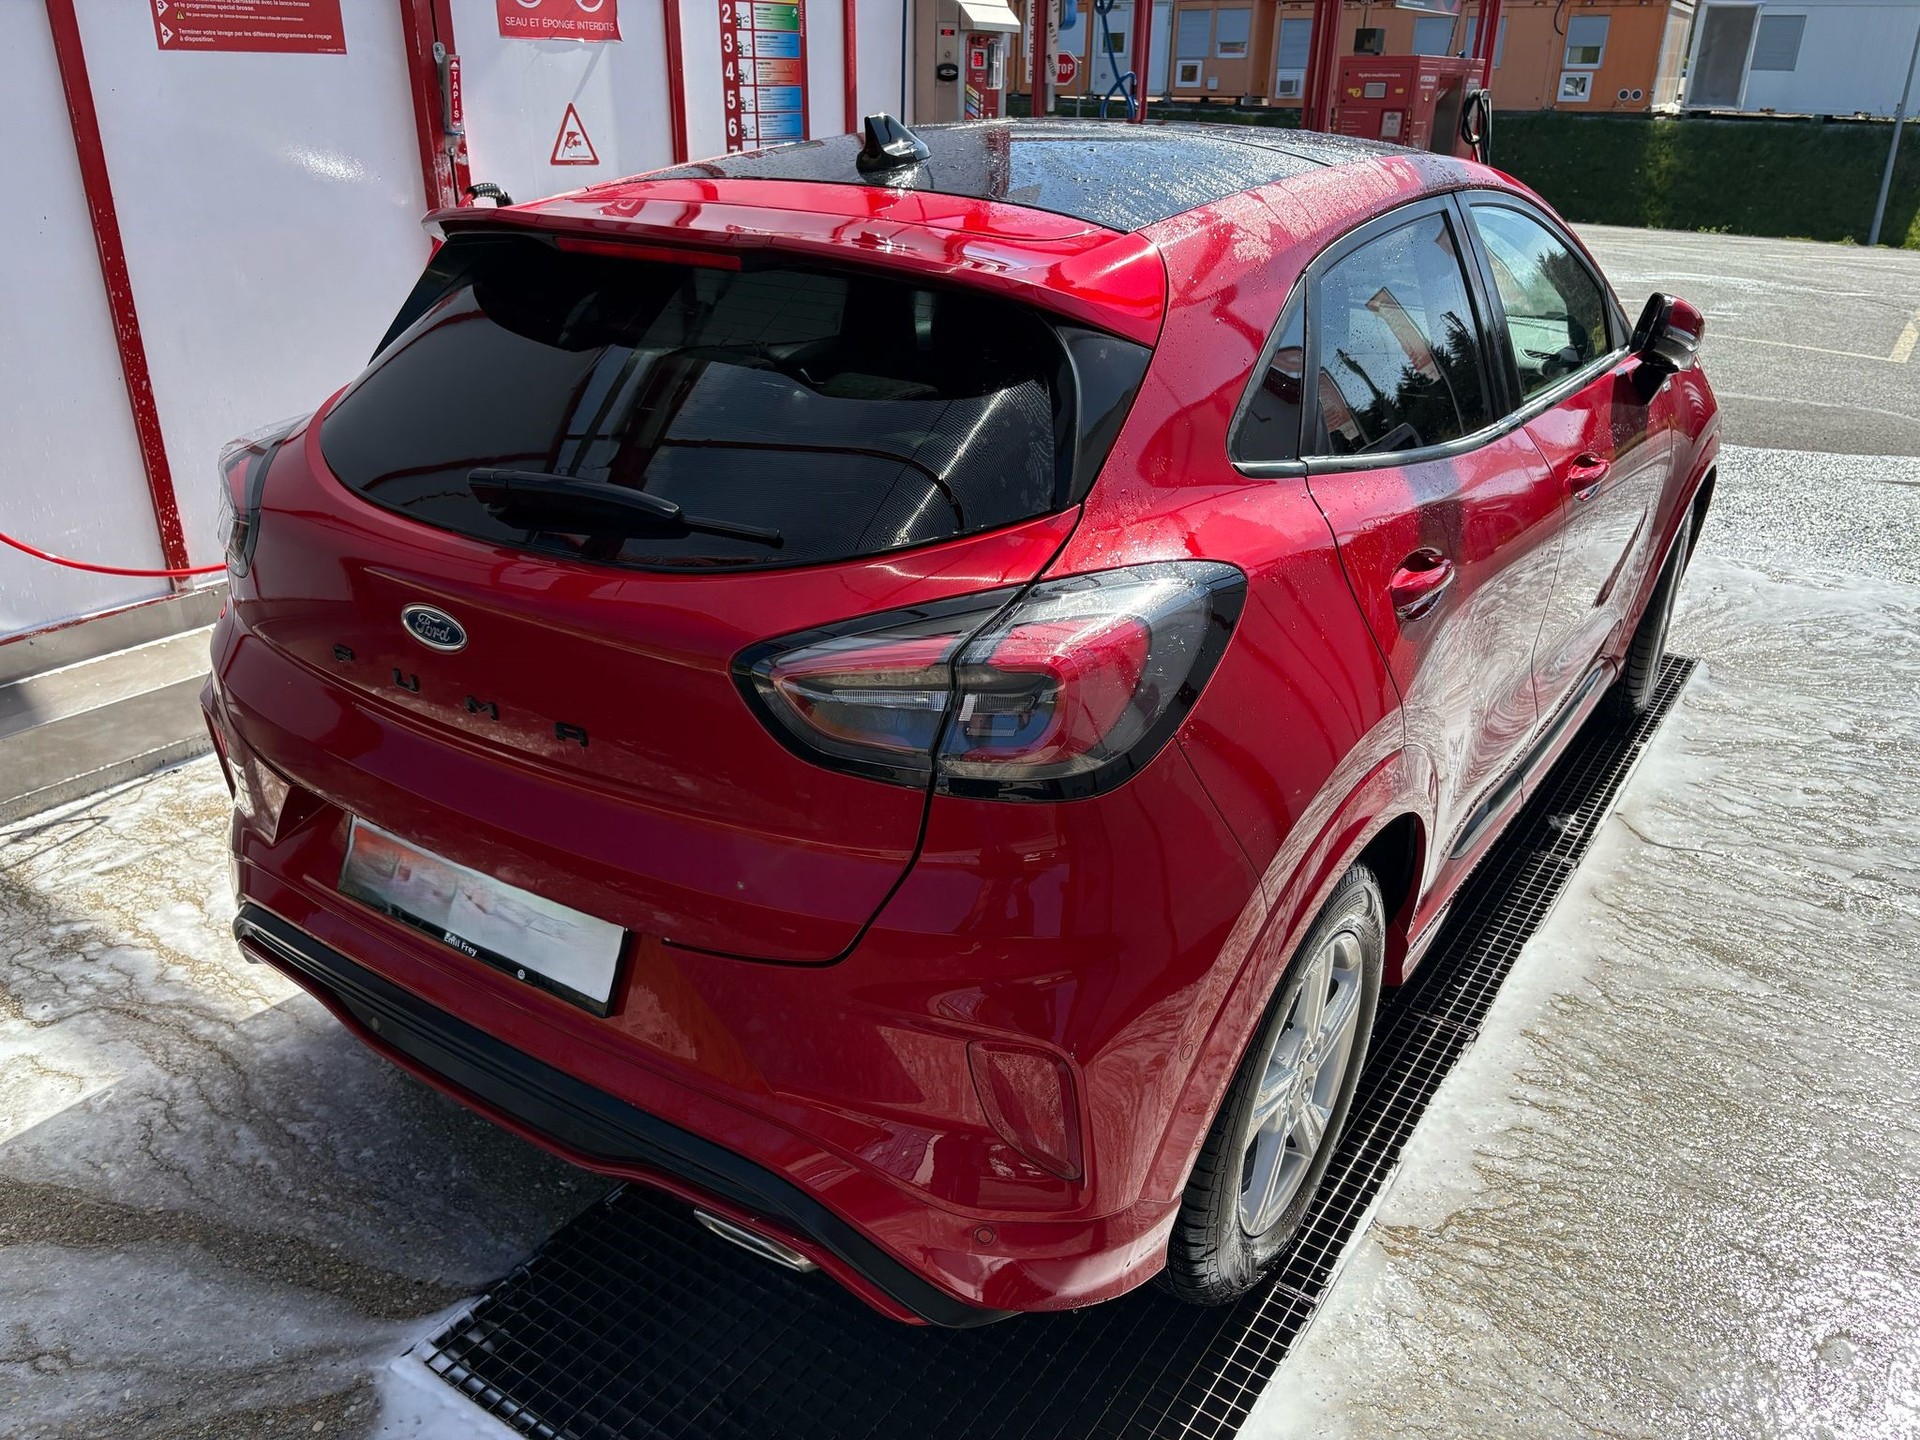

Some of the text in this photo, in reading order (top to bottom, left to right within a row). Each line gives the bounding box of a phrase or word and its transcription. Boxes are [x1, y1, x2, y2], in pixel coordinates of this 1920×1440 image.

[158, 1, 164, 10] 3
[721, 3, 732, 24] 2
[162, 29, 169, 37] 4
[505, 16, 615, 32] SEAU ET ÉPONGE INTERDITS
[723, 32, 733, 54] 3
[725, 61, 735, 81] 4
[1058, 63, 1074, 75] TOP
[451, 71, 460, 119] TAPIS
[727, 90, 737, 110] 5
[728, 117, 738, 137] 6
[416, 612, 451, 642] Ford
[333, 643, 589, 747] PUMA
[444, 931, 478, 957] Emil Frey
